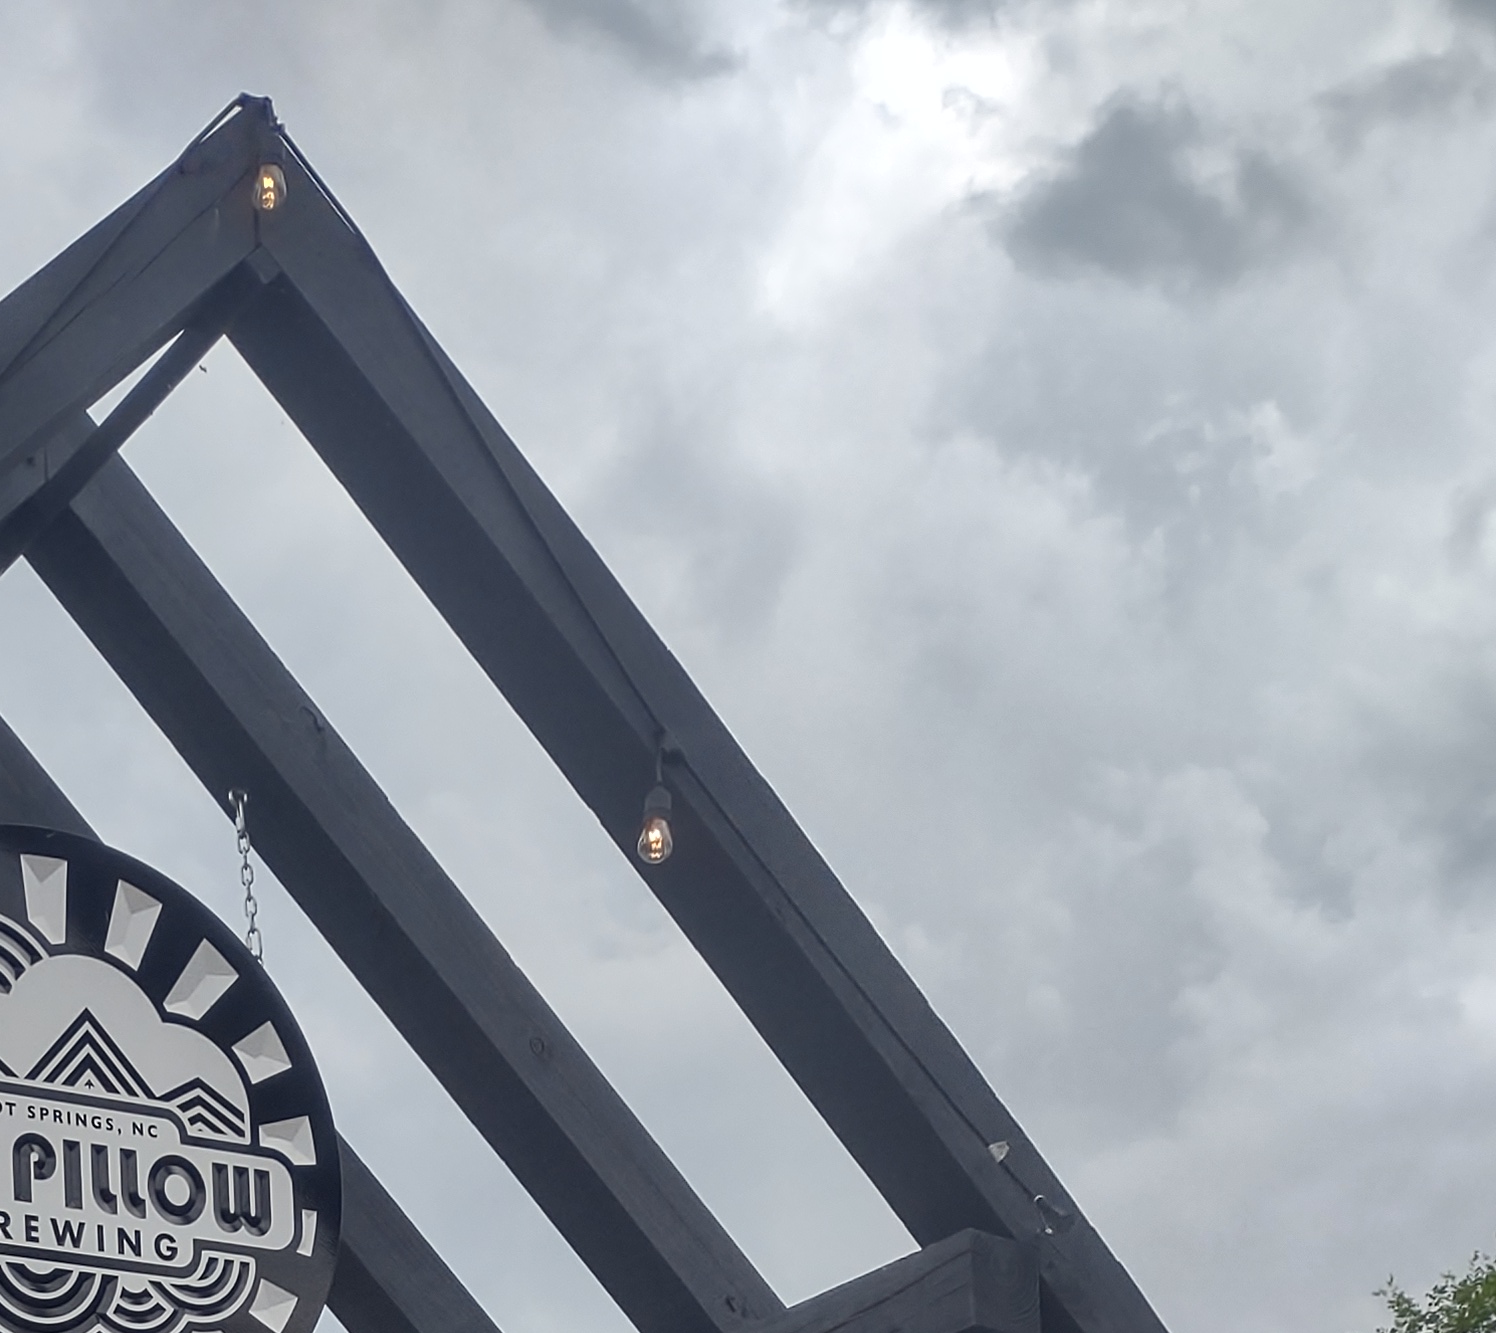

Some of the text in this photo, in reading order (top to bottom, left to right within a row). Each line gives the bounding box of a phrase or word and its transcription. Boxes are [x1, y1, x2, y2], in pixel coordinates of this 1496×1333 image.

[28, 1105, 123, 1135] SPRINGS,
[132, 1121, 159, 1138] NC
[12, 1132, 272, 1237] PILLOW
